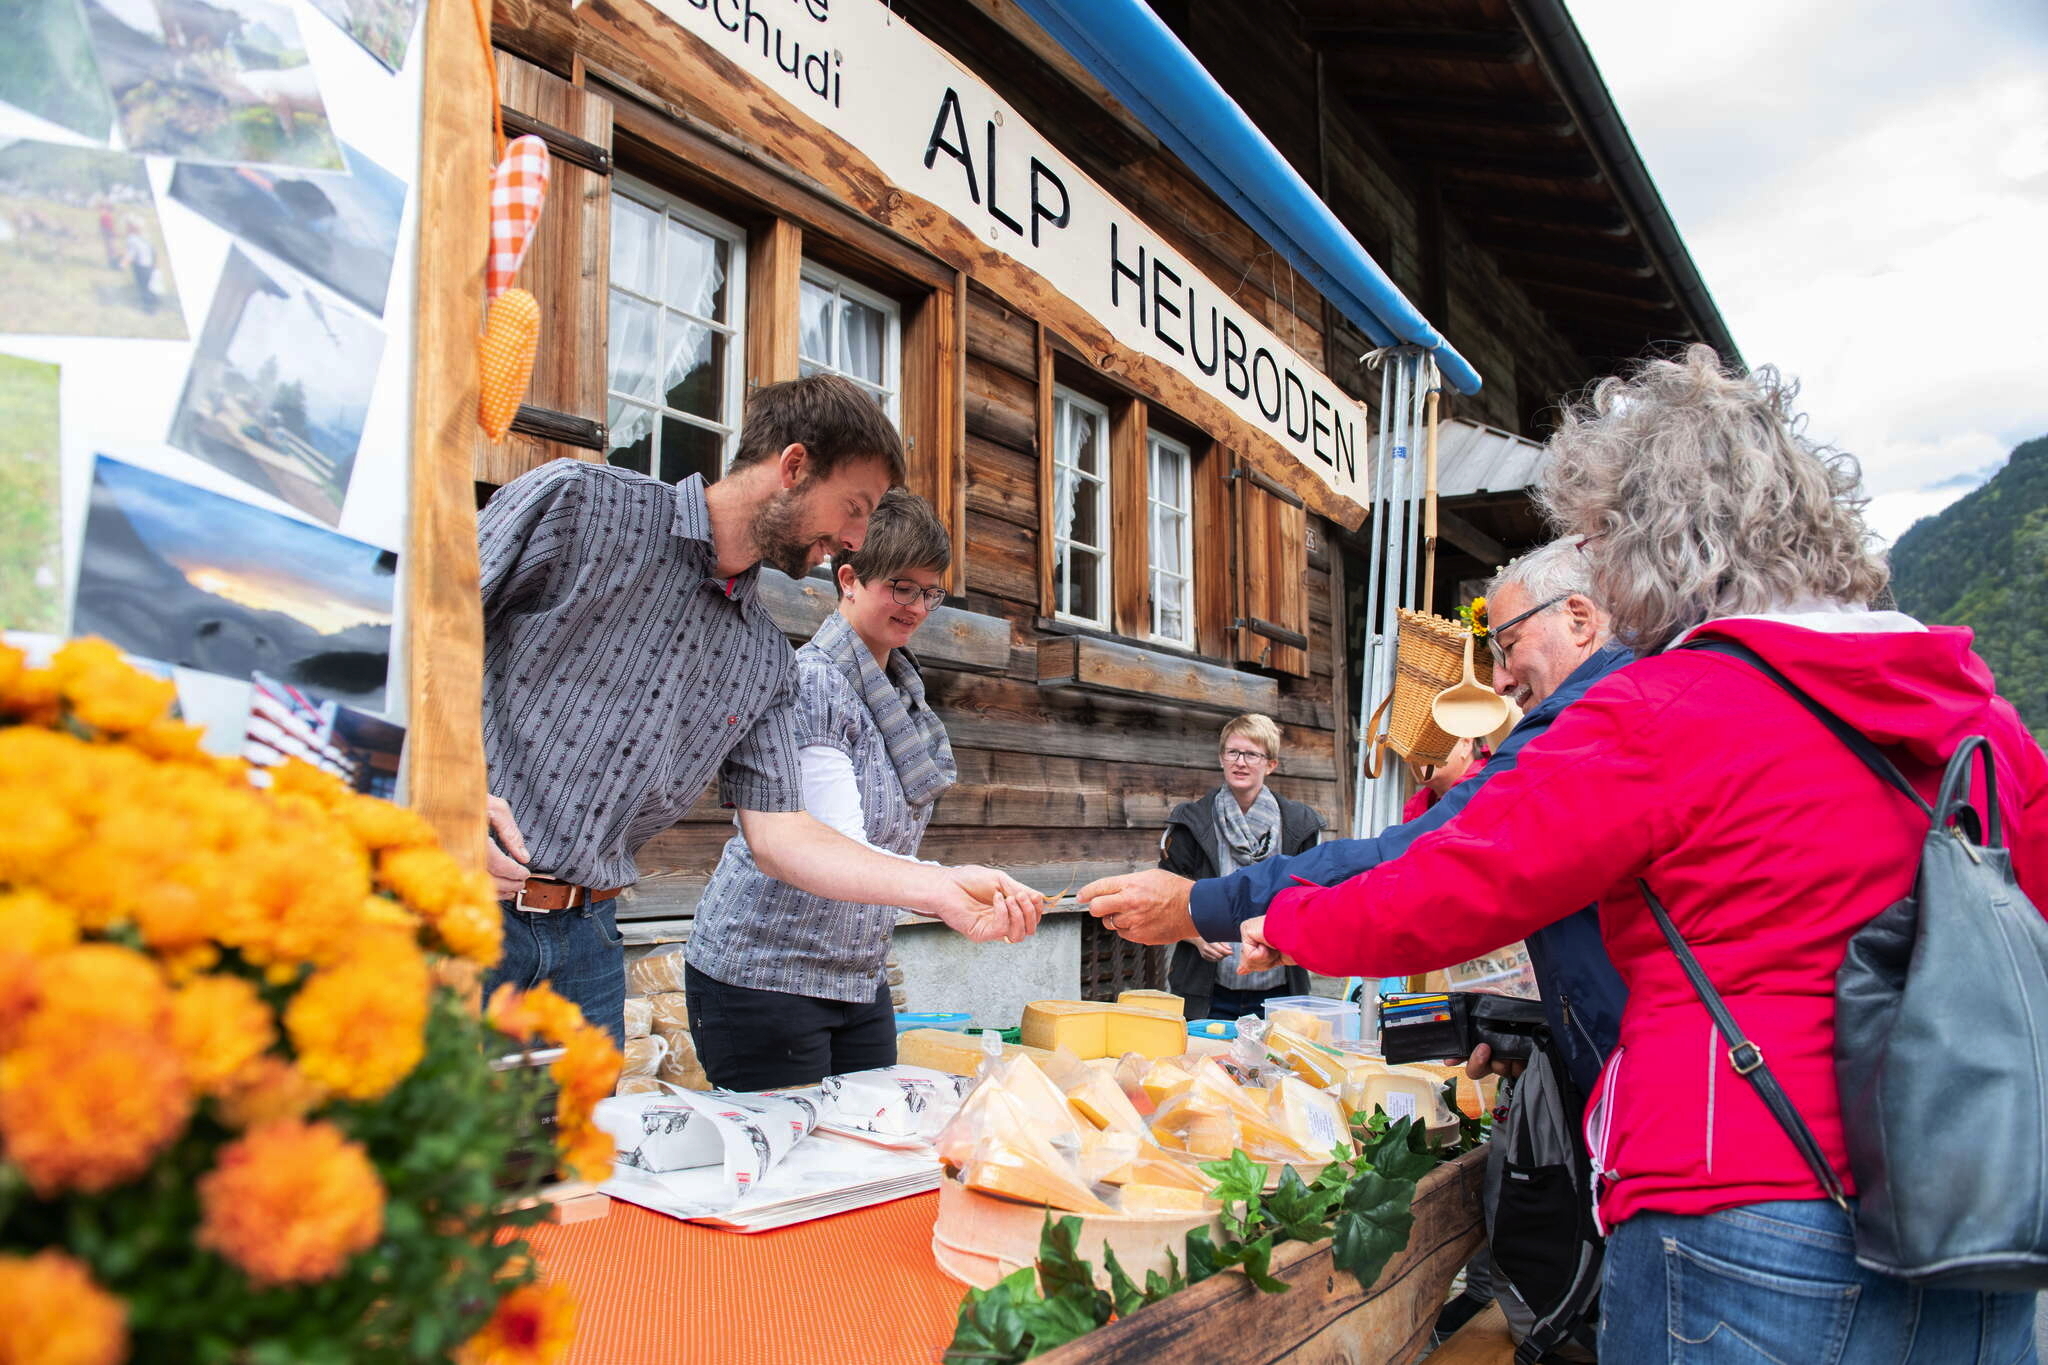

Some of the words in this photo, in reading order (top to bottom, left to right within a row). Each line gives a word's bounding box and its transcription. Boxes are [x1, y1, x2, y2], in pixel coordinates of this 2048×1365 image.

[687, 0, 841, 108] chudi
[923, 87, 1071, 249] ALP
[1110, 222, 1356, 484] HEUBODEN
